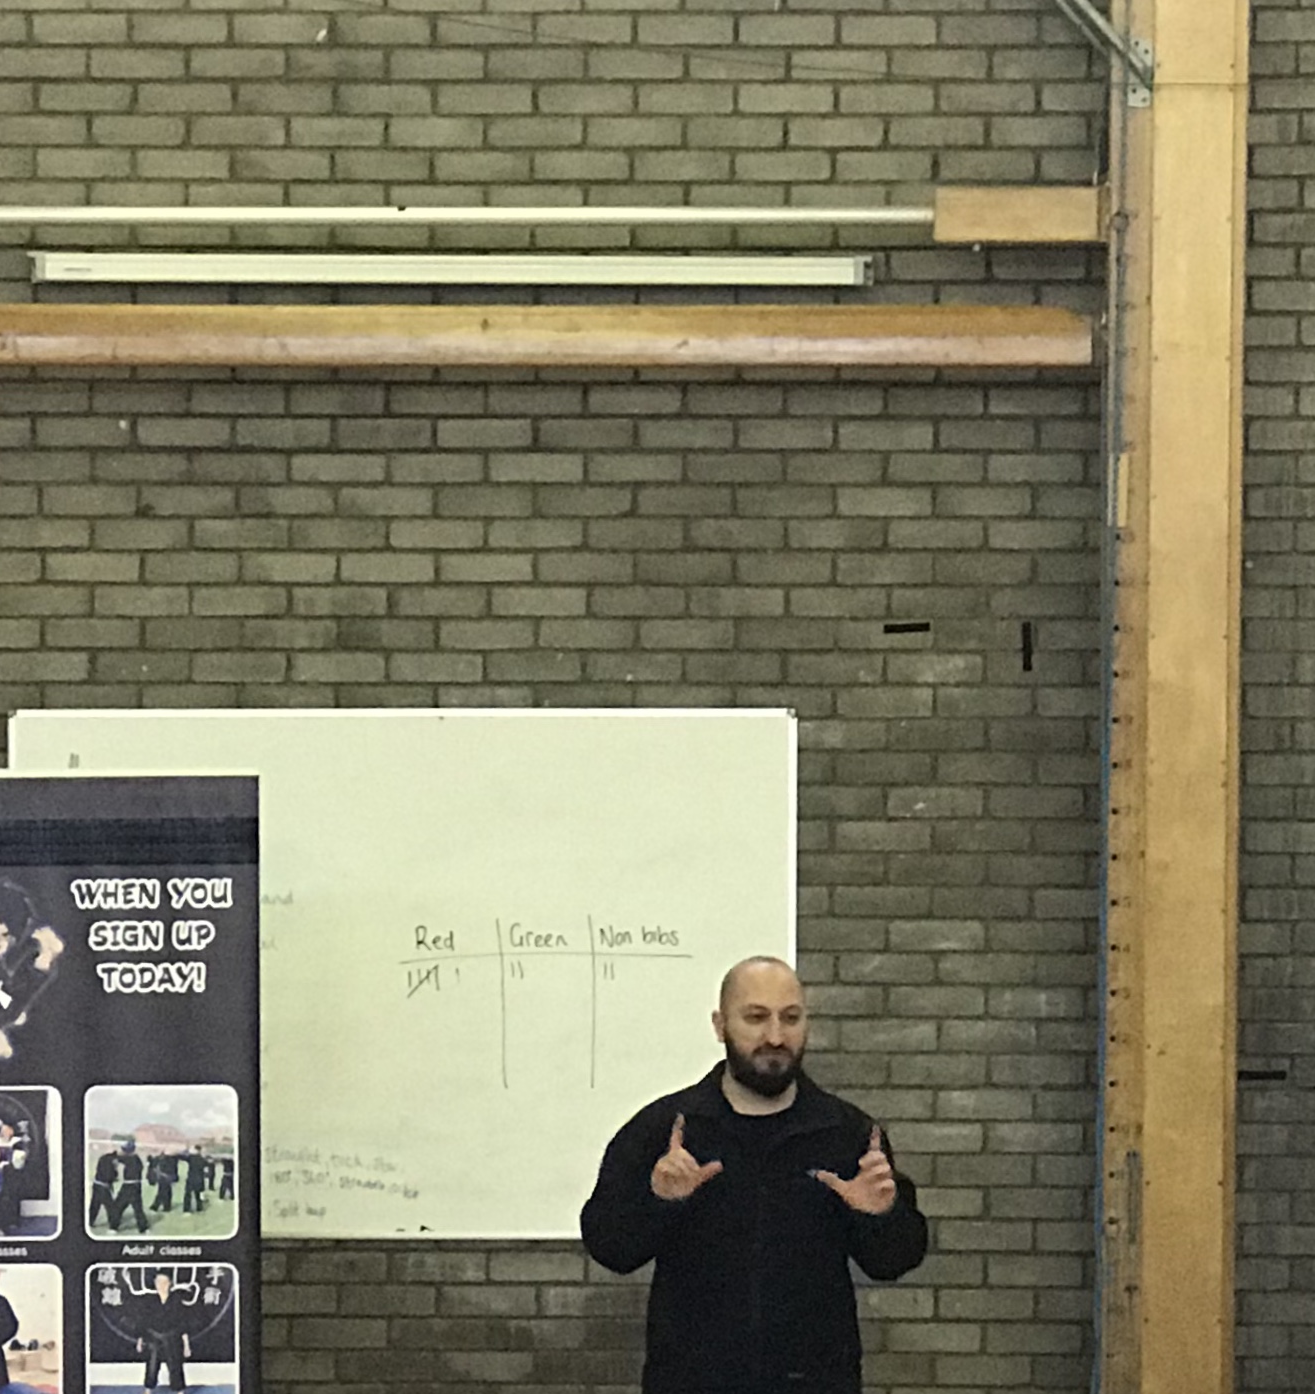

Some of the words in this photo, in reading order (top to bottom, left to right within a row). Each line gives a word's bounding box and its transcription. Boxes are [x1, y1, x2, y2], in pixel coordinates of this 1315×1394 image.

[70, 878, 161, 910] WHEN
[166, 877, 234, 910] YOU
[88, 920, 165, 952] SIGN
[171, 919, 216, 951] UP
[415, 924, 455, 951] Red
[509, 922, 568, 948] Green
[599, 923, 632, 946] Non
[642, 924, 679, 947] bibs
[96, 961, 207, 994] TODAY!
[122, 1244, 155, 1256] Adult
[159, 1244, 202, 1256] classes
